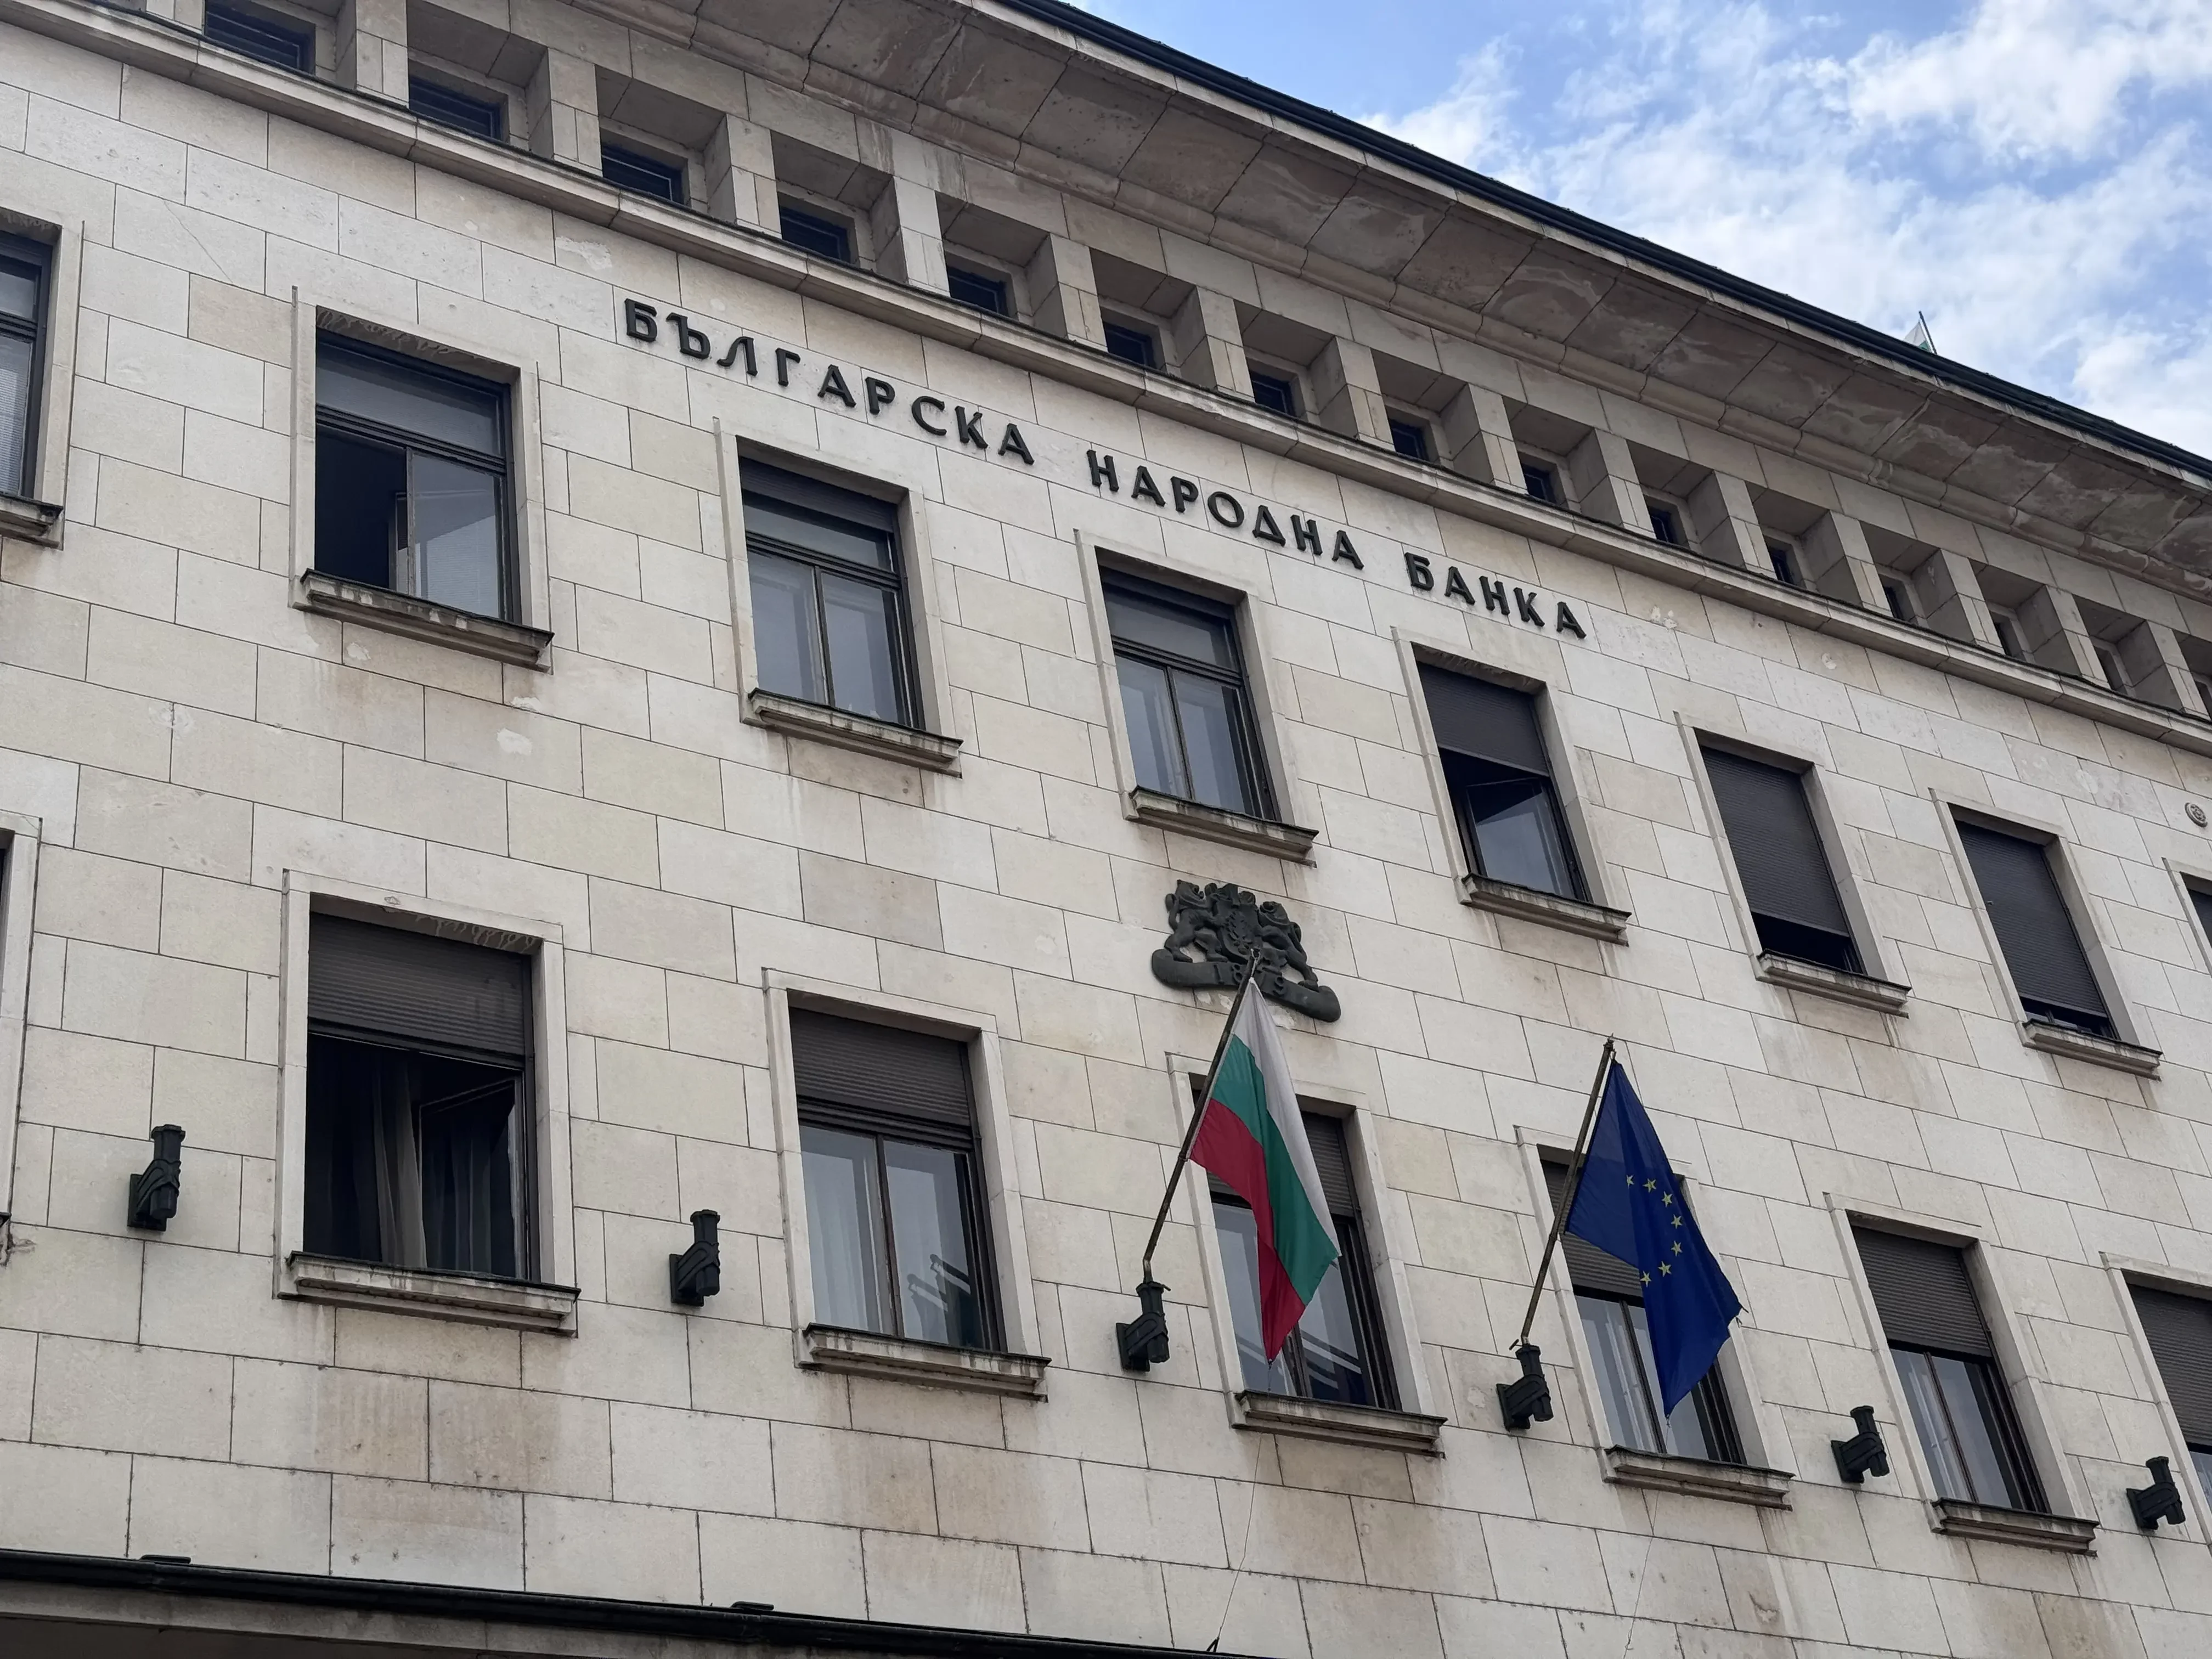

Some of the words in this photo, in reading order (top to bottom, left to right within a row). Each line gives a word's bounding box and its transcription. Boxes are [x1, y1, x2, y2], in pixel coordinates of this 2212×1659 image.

[624, 297, 1035, 466] БЪЛГАРСКА
[1086, 449, 1365, 571] НАРОДНА
[1403, 551, 1587, 640] БАНКА
